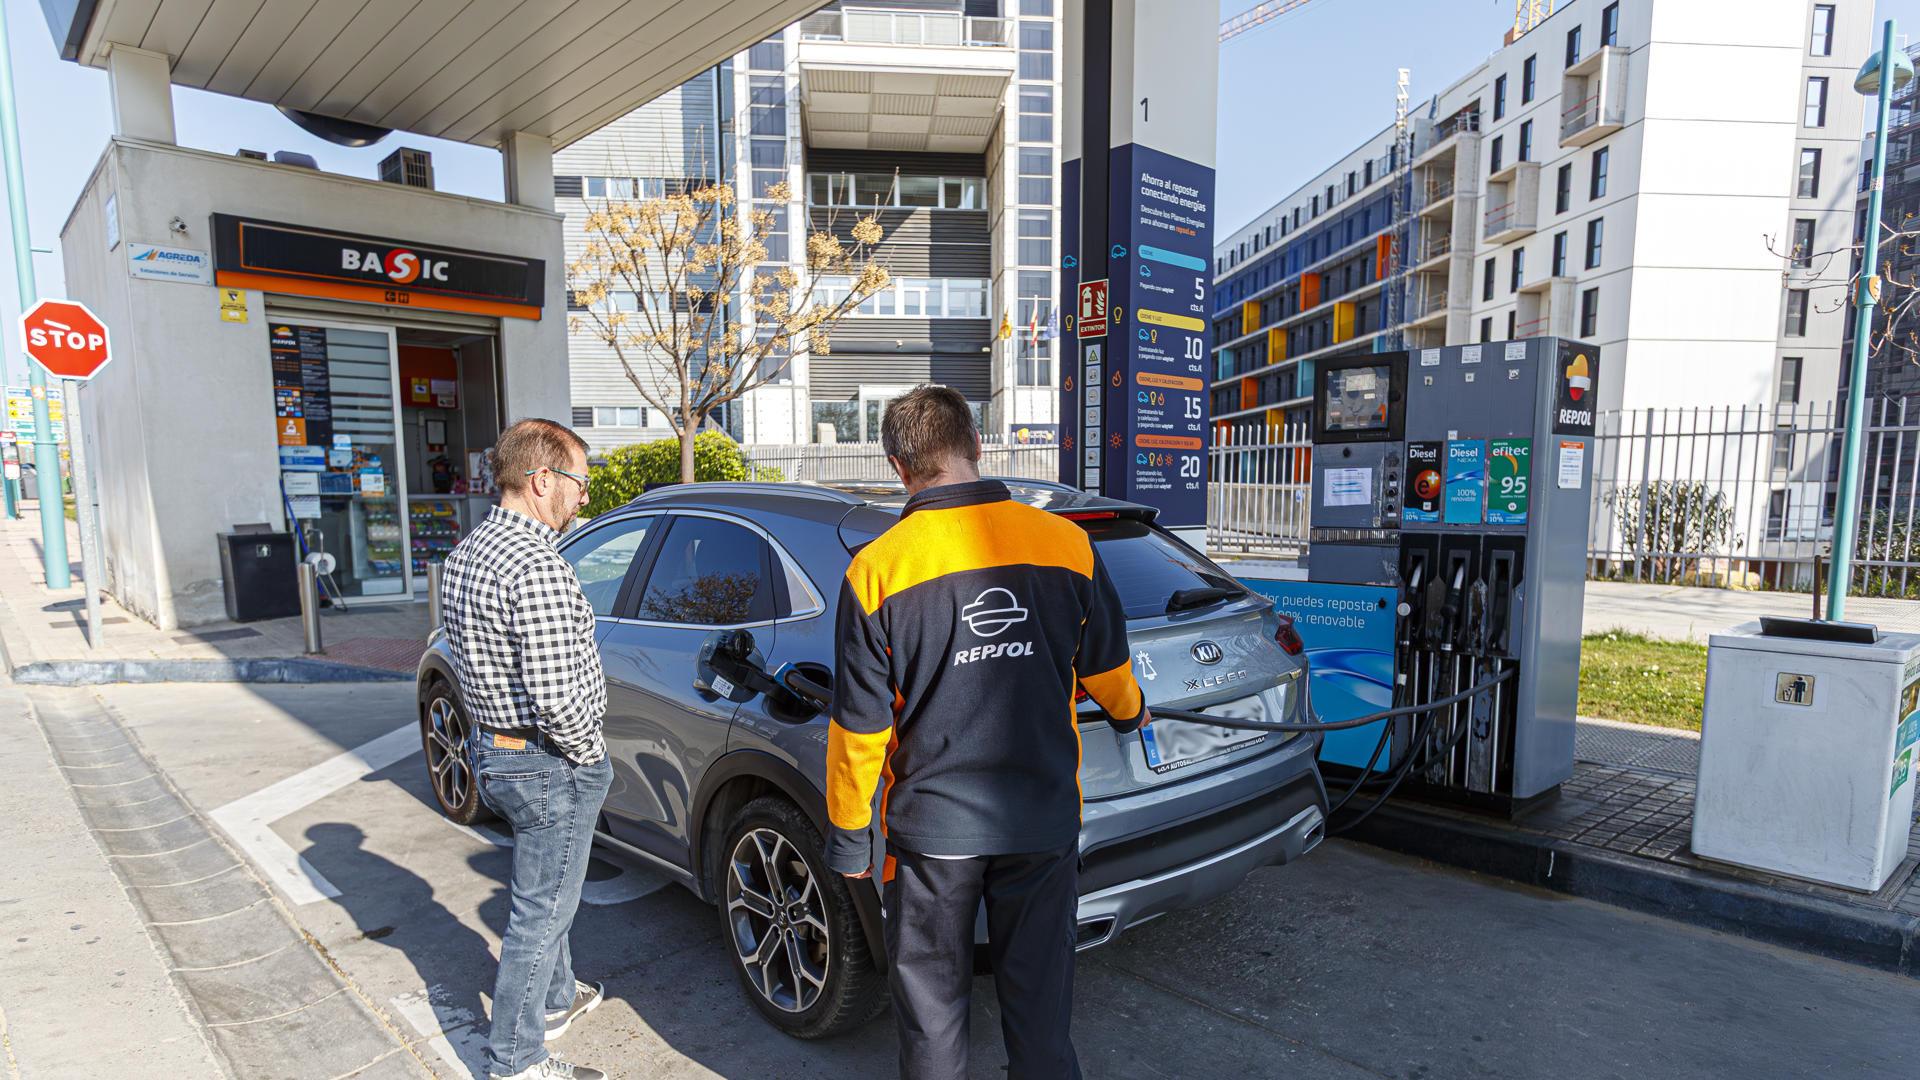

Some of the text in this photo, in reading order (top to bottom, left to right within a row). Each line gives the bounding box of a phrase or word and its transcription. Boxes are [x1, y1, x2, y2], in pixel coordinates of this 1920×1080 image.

[1140, 97, 1148, 122] 1
[1141, 172, 1199, 198] Ahorra al repostar
[1141, 186, 1206, 212] conectando energías
[1140, 204, 1163, 217] Descubre
[1170, 212, 1186, 223] Planes
[1140, 216, 1152, 226] para
[158, 251, 201, 263] AGREDA
[341, 248, 449, 282] BASIC
[1194, 277, 1204, 300] 5
[1080, 324, 1106, 333] EXTINTOR
[30, 328, 104, 351] STOP
[1184, 336, 1203, 360] 10
[1184, 396, 1202, 419] 15
[1559, 408, 1592, 426] REPSOL
[1409, 448, 1437, 459] Diesel
[1450, 447, 1478, 458] Diesel
[1492, 446, 1528, 457] efitec
[1180, 455, 1200, 478] 20
[1457, 489, 1477, 497] 100%
[1500, 476, 1527, 494] 95
[1282, 595, 1324, 608] puedes
[1327, 598, 1378, 613] repostar
[1306, 613, 1365, 629] renovable
[953, 641, 1034, 667] REPSOL
[1196, 644, 1221, 661] KIA
